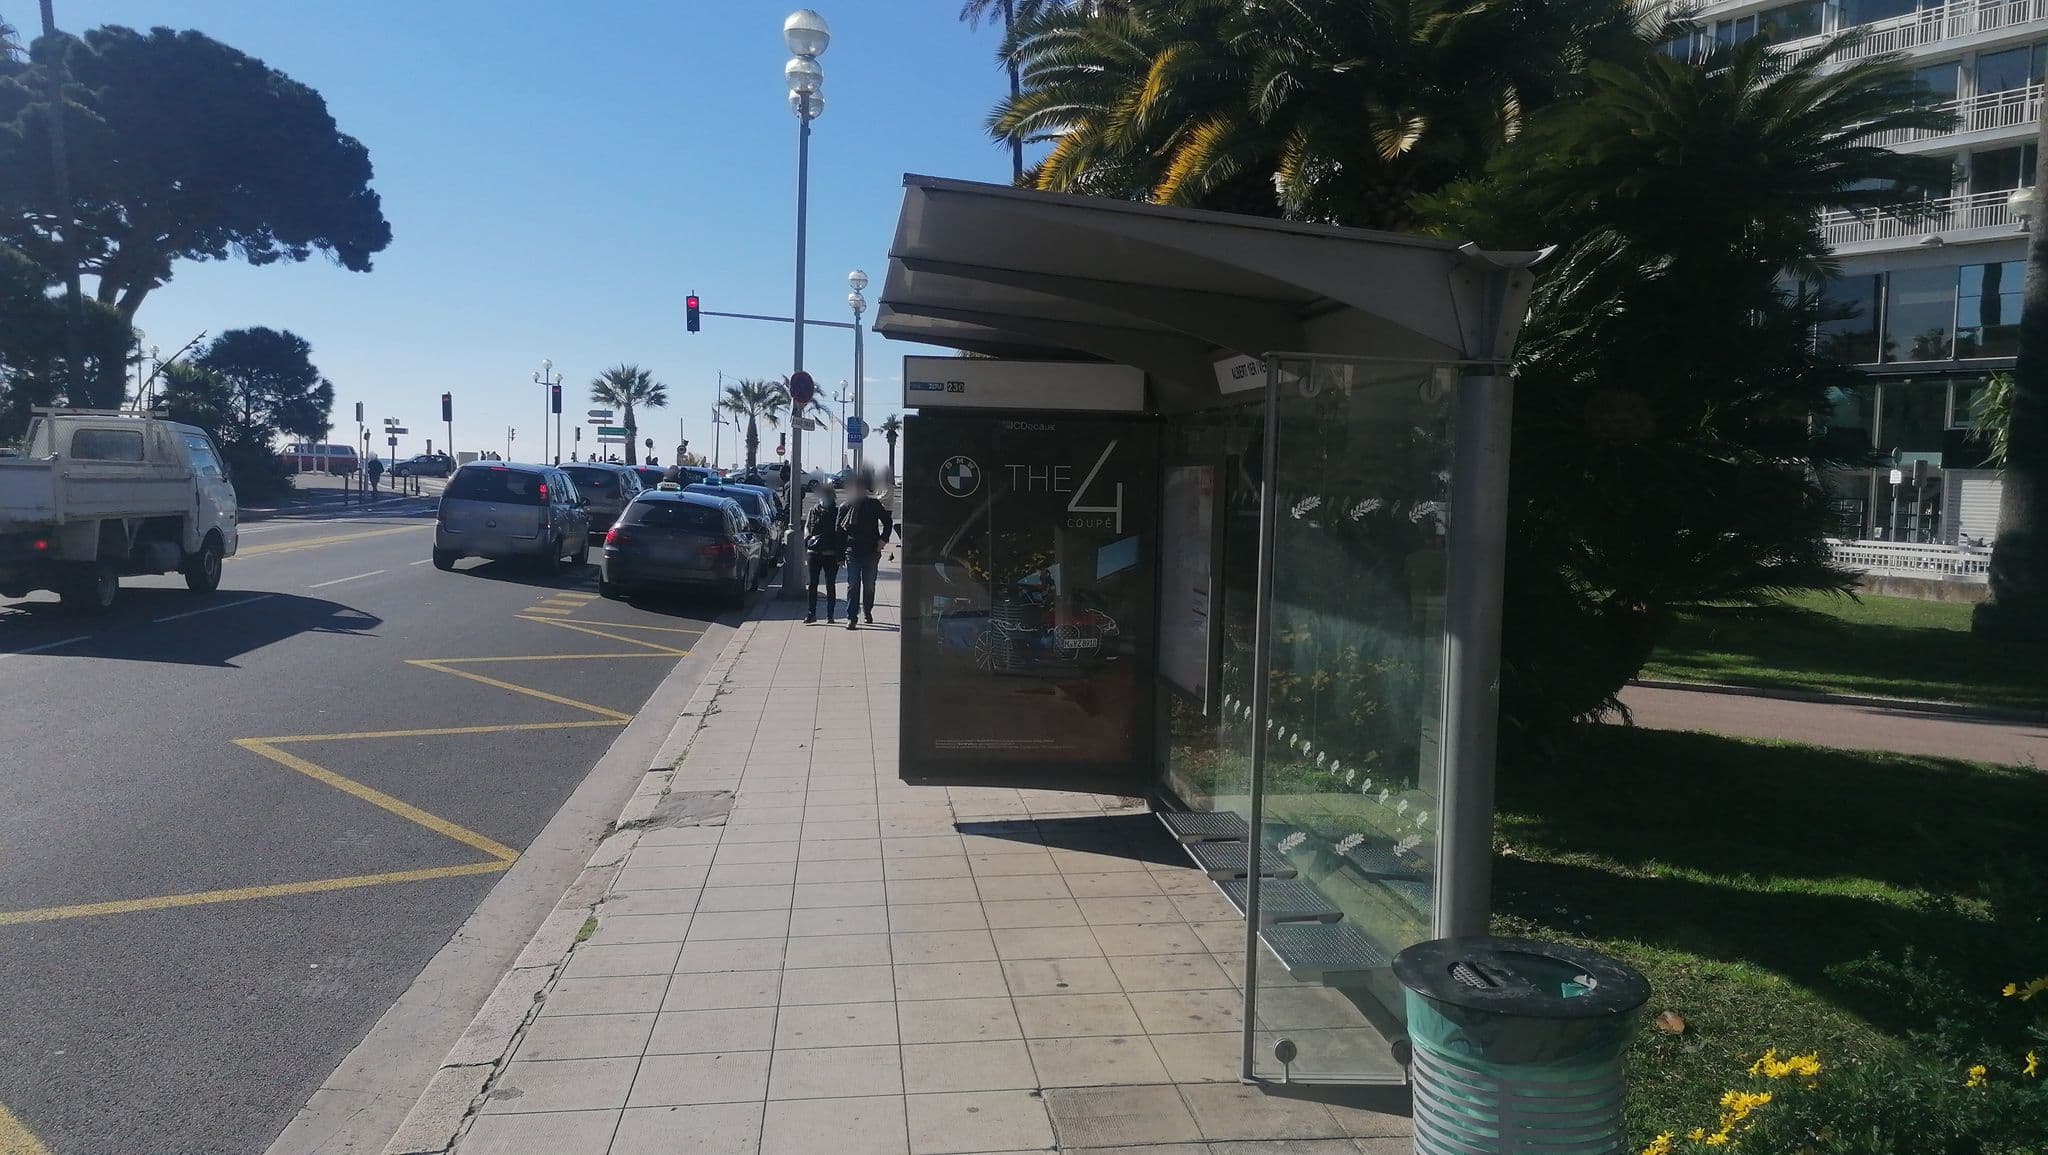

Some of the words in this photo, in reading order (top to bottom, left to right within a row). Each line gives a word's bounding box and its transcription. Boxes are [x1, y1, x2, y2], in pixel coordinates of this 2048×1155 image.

[947, 383, 964, 392] 230
[1004, 464, 1072, 492] THE
[1067, 440, 1123, 534] 4
[1066, 516, 1113, 528] COUPÉ
